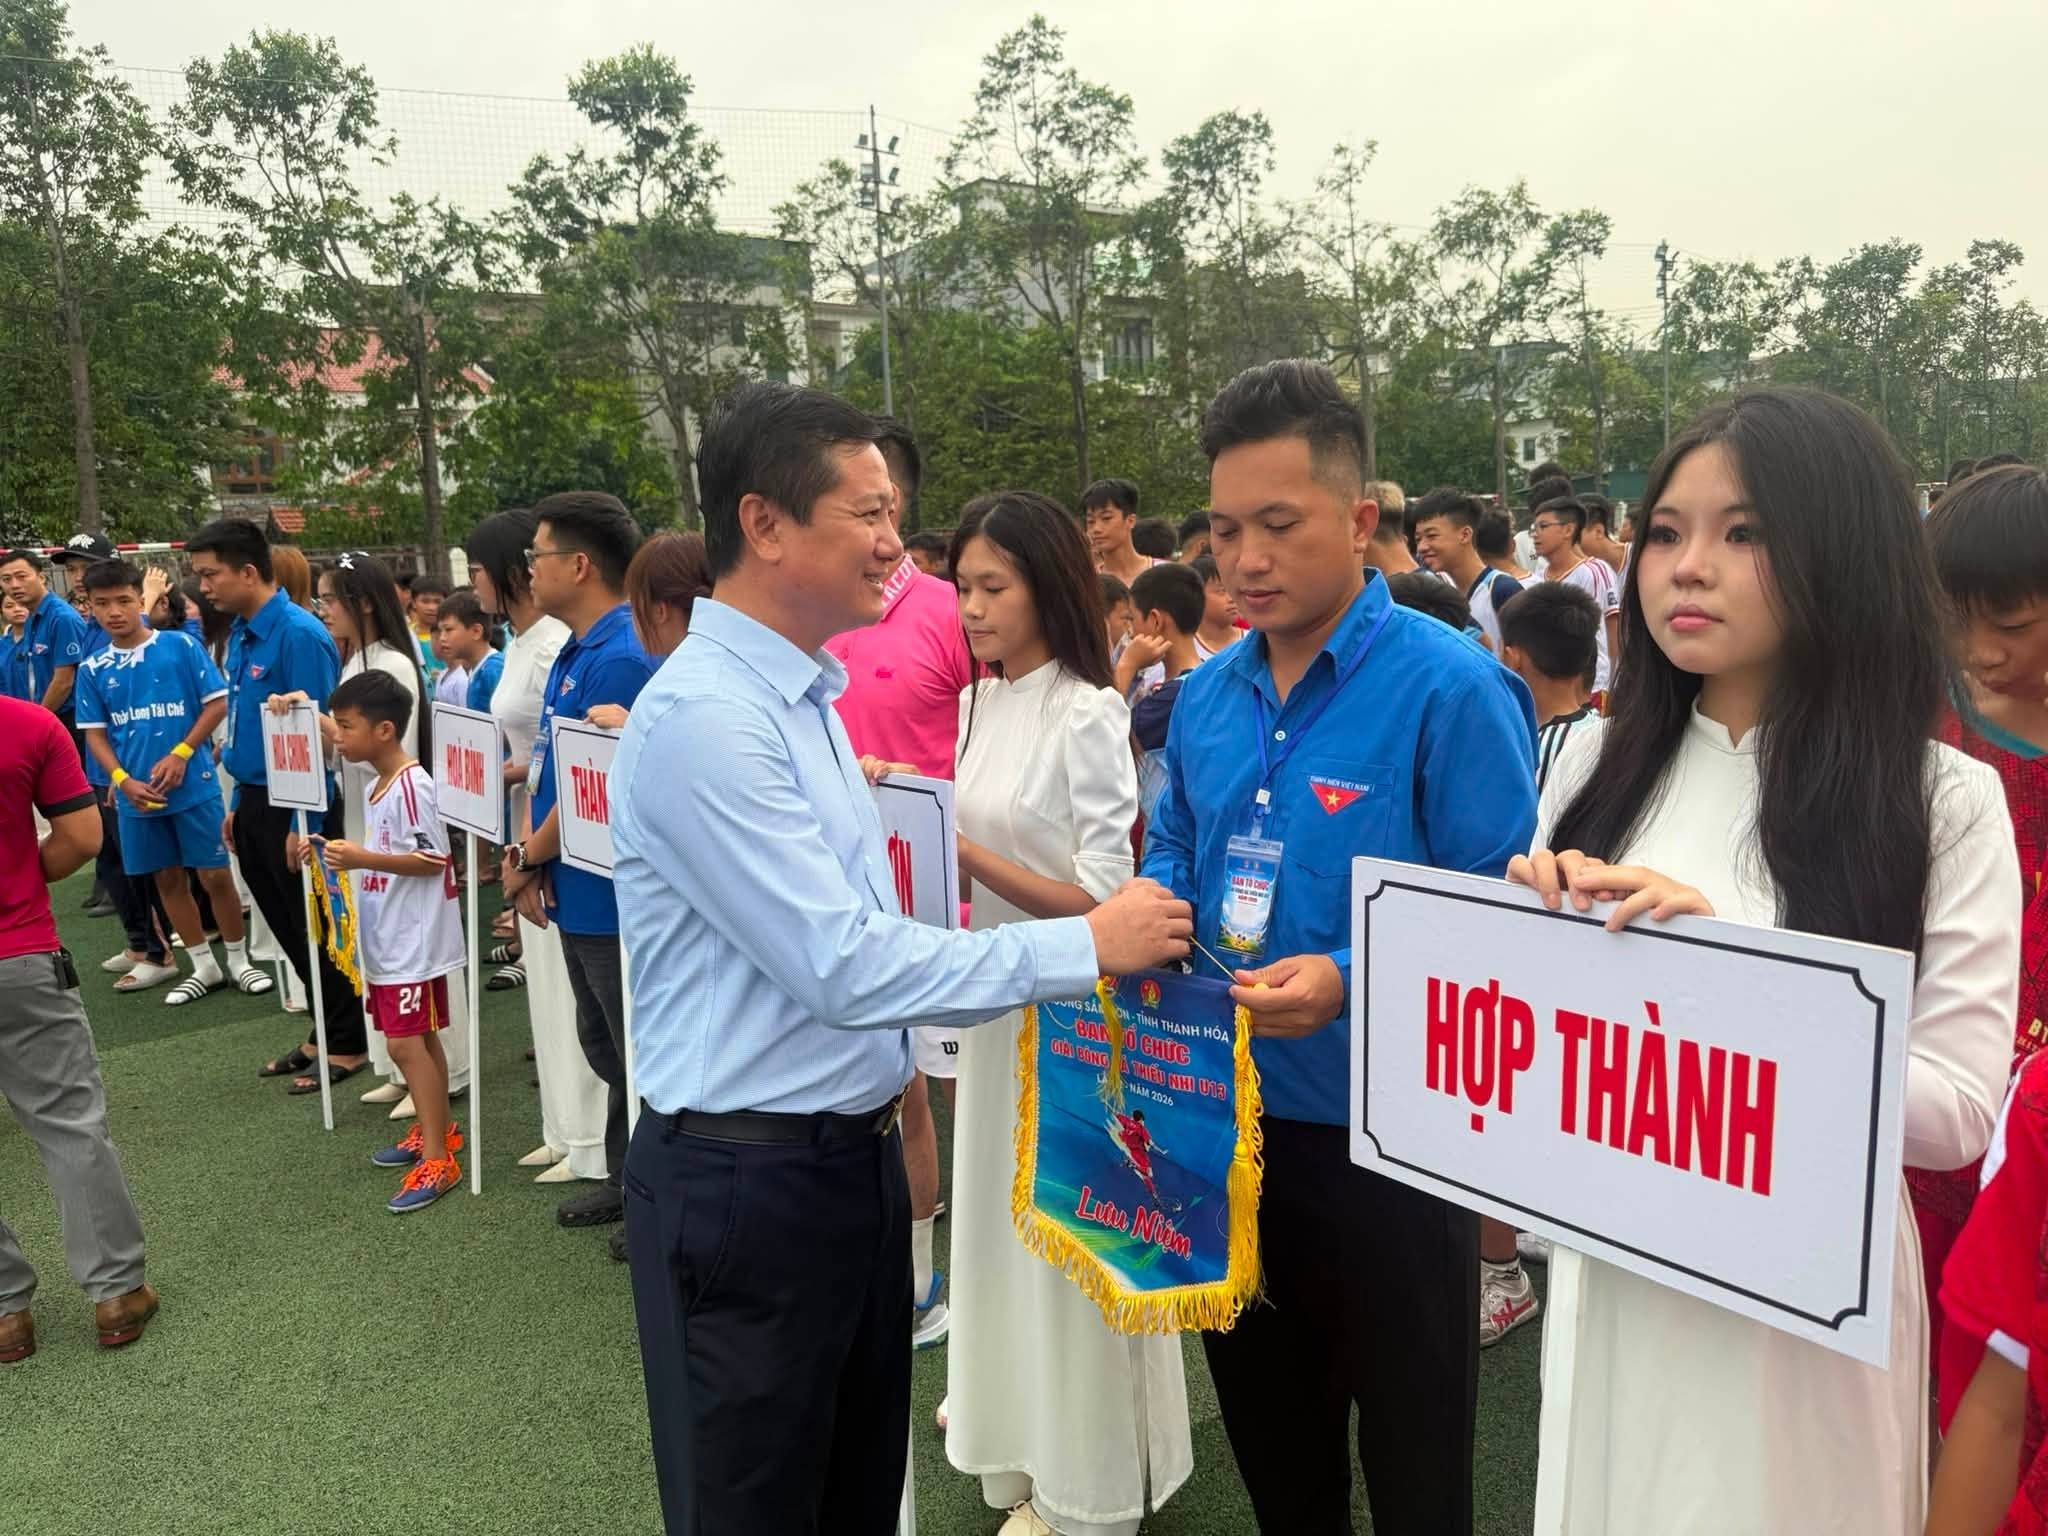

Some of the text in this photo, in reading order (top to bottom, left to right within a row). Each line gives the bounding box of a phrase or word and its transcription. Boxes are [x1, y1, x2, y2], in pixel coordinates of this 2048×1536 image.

[129, 705, 150, 720] Long
[150, 703, 166, 718] Tái
[446, 736, 463, 790] HOÀ
[464, 739, 485, 797] BÌNH
[570, 757, 609, 826] THÀN
[887, 829, 914, 917] ƠN
[399, 986, 422, 1015] 24
[1161, 1019, 1201, 1037] THANH
[1203, 1024, 1230, 1043] HÓA
[1140, 1034, 1191, 1066] CHỨC
[1150, 1090, 1175, 1107] 2026
[1168, 1072, 1196, 1094] NHI
[1198, 1076, 1228, 1101] U13
[1426, 975, 1778, 1197] HỢP THÀNH
[1075, 1185, 1193, 1261] Lưu Niệm
